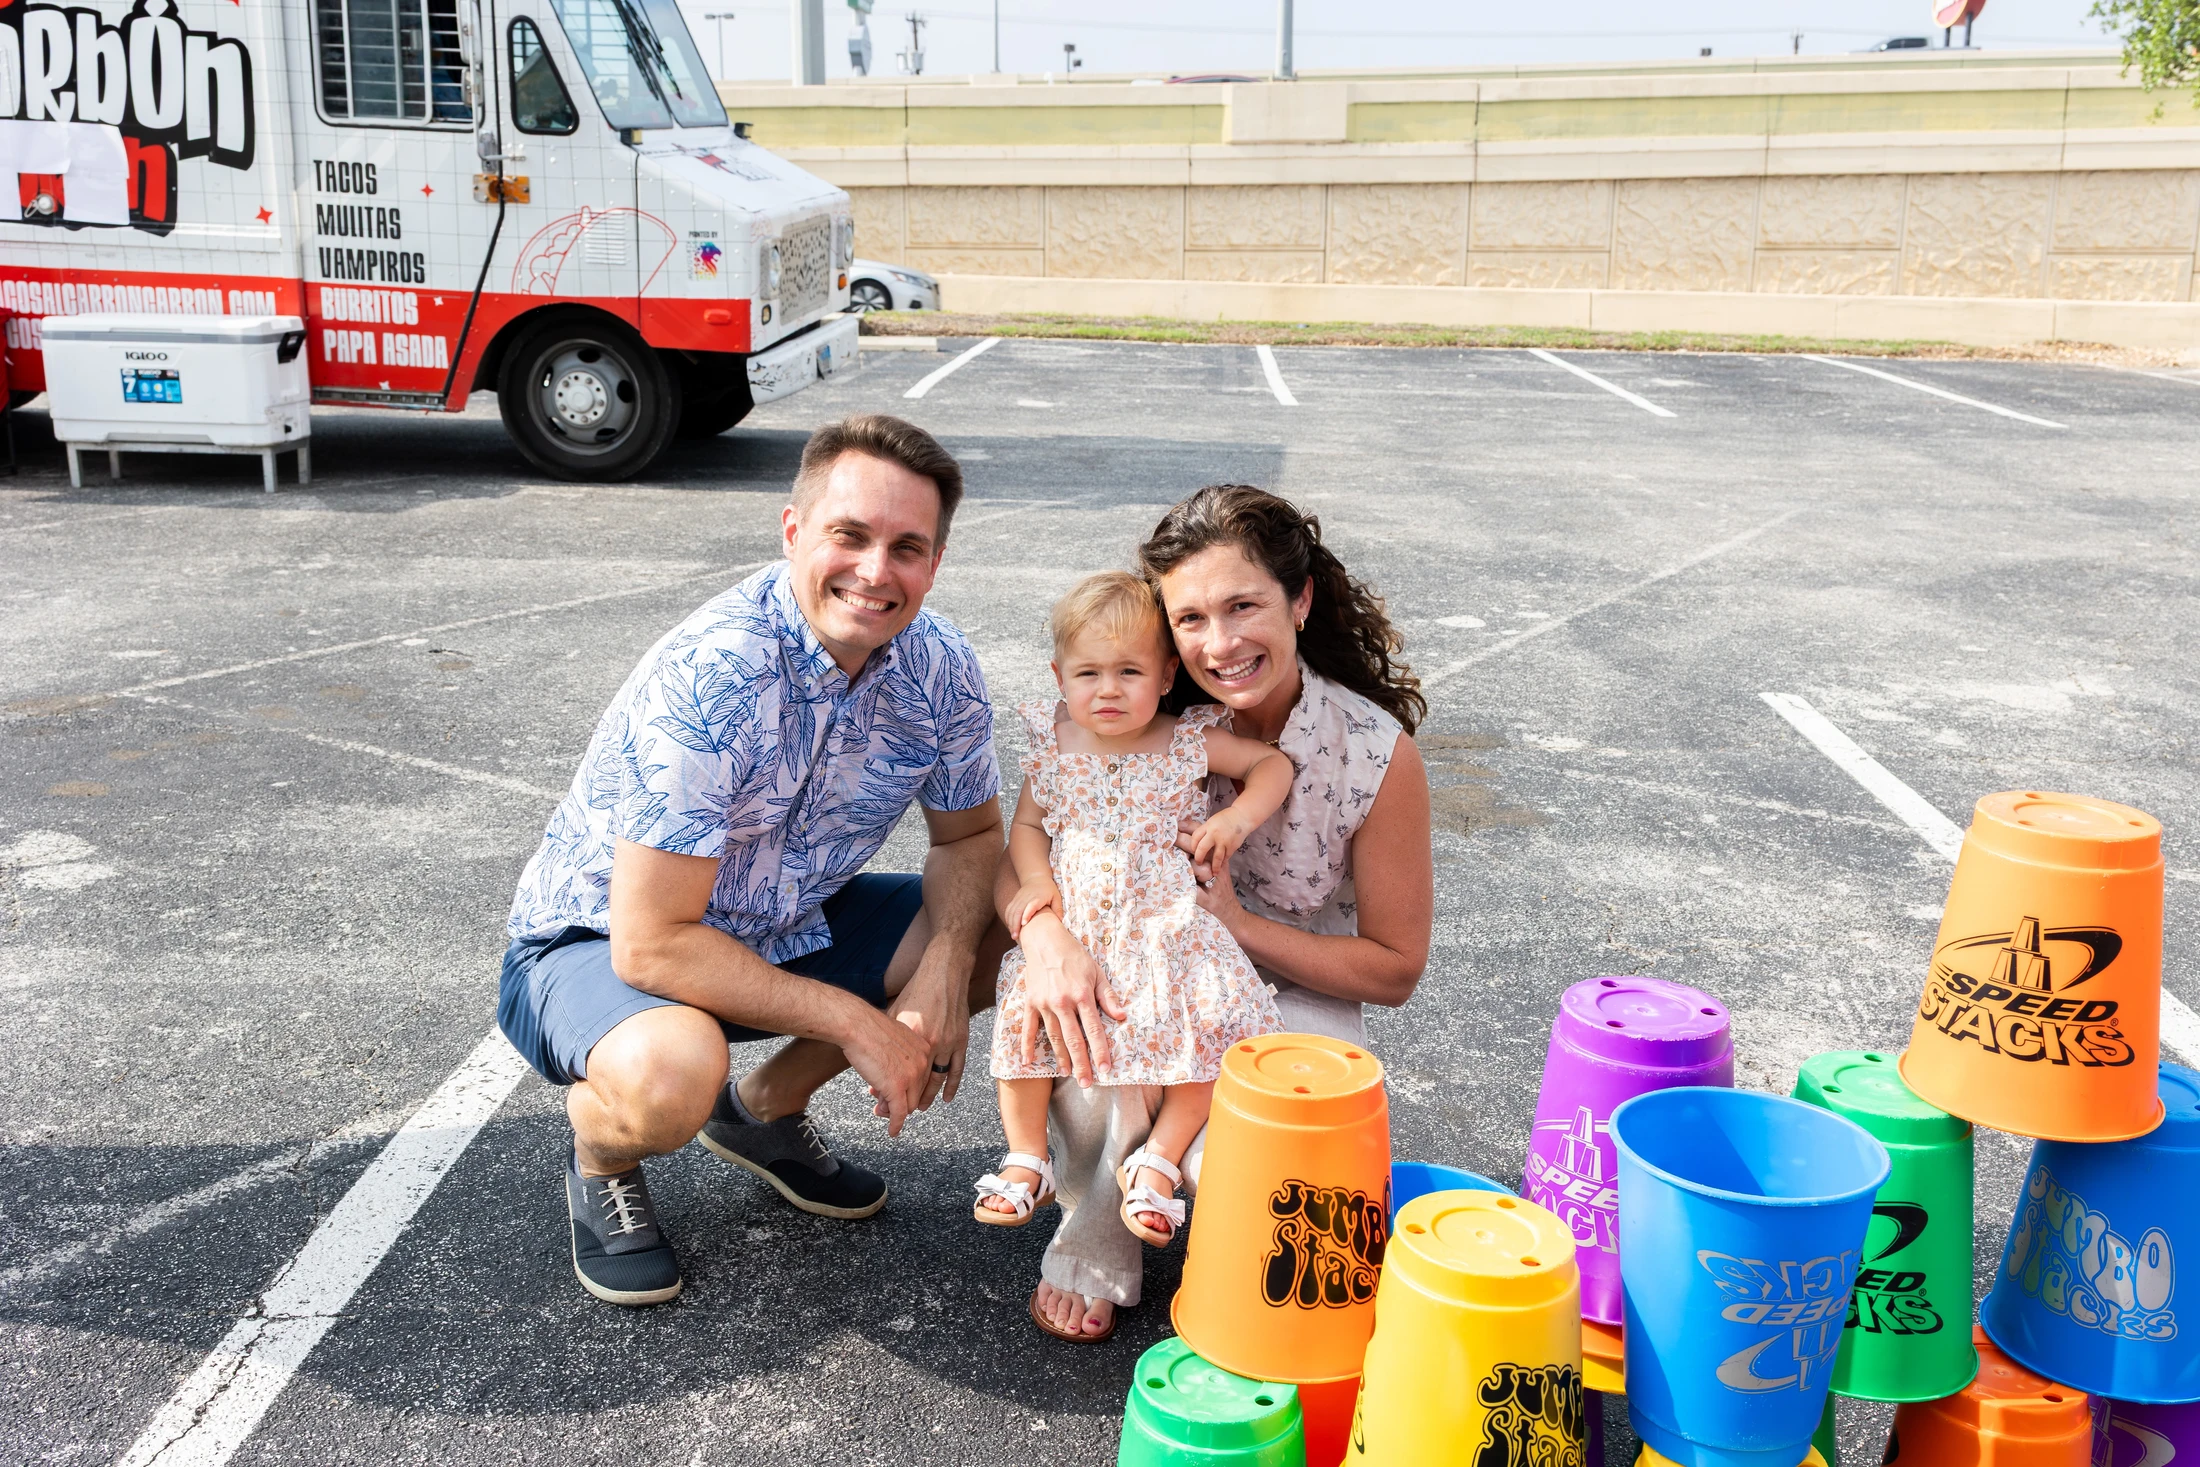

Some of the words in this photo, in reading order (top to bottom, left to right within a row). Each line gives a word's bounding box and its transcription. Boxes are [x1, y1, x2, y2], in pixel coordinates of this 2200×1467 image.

[313, 159, 377, 195] TACOS
[316, 203, 401, 240] MULITAS
[319, 247, 426, 284] VAMPIROS
[320, 286, 419, 326] BURRITOS
[125, 351, 168, 361] IGLOO
[323, 329, 377, 365] PAPA
[382, 332, 449, 369] ASADA
[1945, 971, 2119, 1023] SPEED
[1921, 981, 2135, 1067] STACKS
[1529, 1152, 1619, 1210] SPEE
[2028, 1164, 2176, 1314] JUMBO
[1261, 1218, 1381, 1310] Stac
[1855, 1267, 1927, 1293] ED
[1476, 1362, 1585, 1443] JUMB
